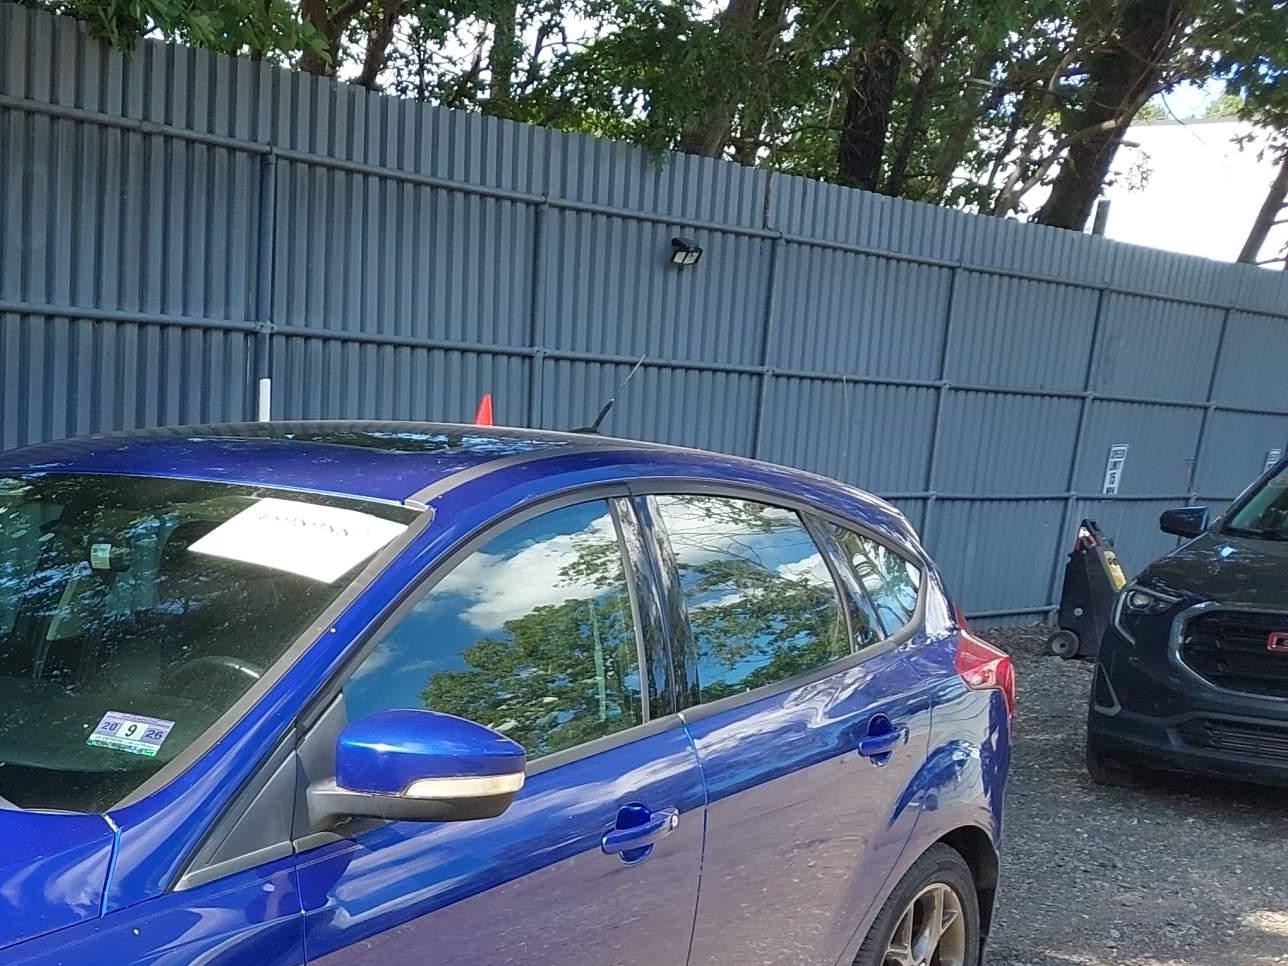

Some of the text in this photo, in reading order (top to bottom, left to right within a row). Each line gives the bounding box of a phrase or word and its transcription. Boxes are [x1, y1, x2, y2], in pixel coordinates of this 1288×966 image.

[101, 721, 164, 740] 20 9 26
